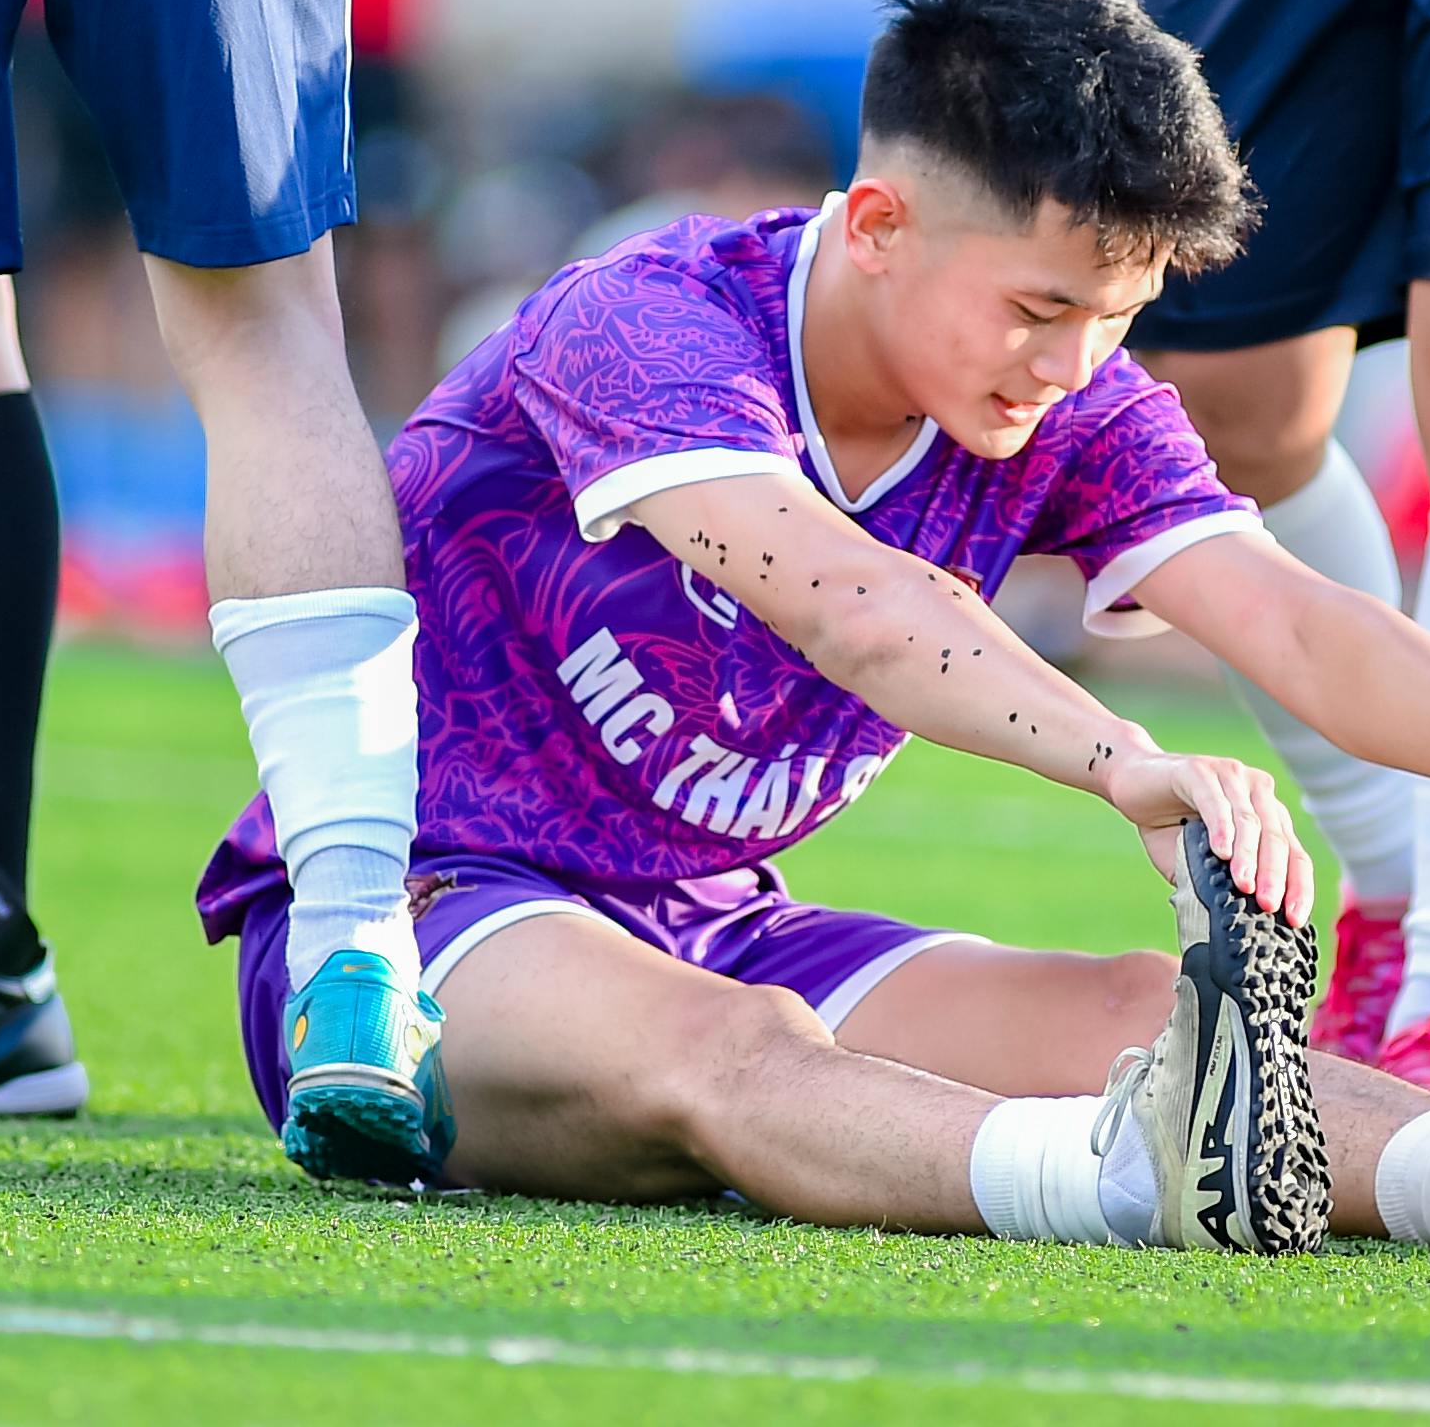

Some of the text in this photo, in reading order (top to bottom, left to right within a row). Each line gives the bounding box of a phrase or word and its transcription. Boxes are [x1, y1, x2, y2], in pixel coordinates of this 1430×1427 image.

[557, 627, 675, 765] MC
[652, 733, 826, 840] THÁI
[1277, 1072, 1298, 1141] ZOOM
